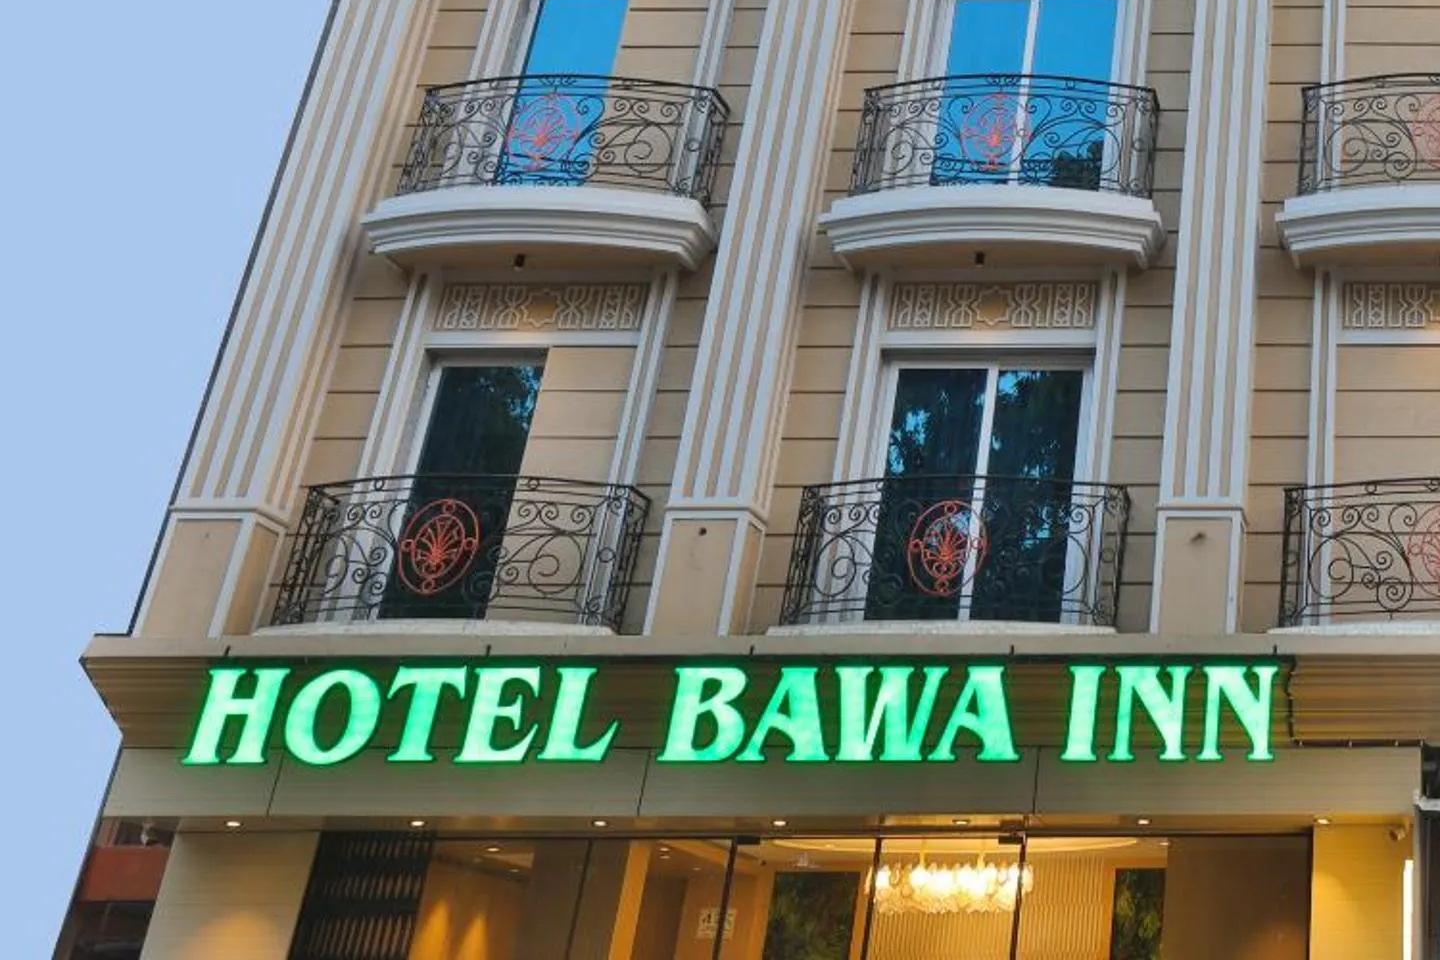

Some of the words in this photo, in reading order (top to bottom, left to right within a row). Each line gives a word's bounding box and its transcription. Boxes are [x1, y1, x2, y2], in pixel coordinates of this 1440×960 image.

[183, 665, 617, 765] HOTEL
[657, 666, 1019, 762] BAWA
[1061, 665, 1278, 761] INN
